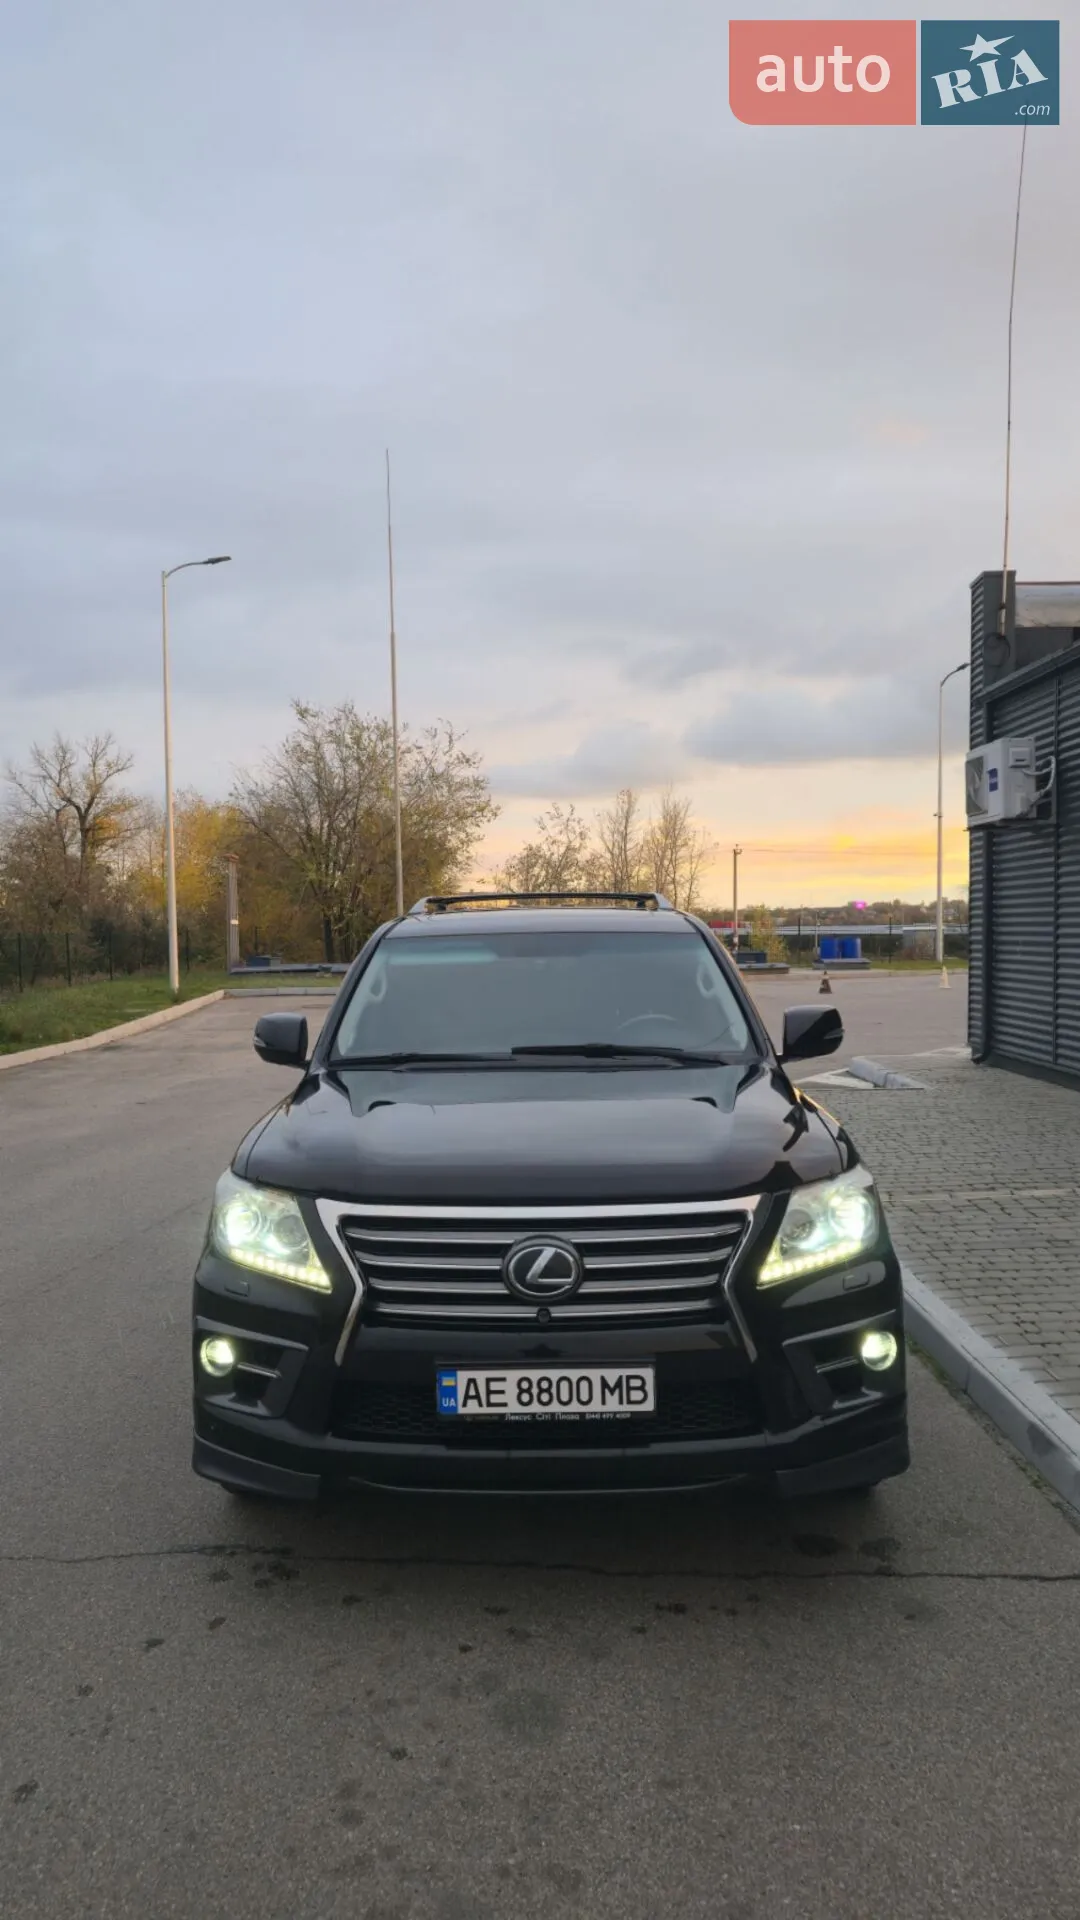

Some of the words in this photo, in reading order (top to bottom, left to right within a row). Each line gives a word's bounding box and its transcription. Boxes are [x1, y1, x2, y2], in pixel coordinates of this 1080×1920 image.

[461, 1377, 508, 1408] AE
[516, 1375, 593, 1407] 8800
[600, 1374, 648, 1406] MB
[442, 1398, 456, 1407] UA
